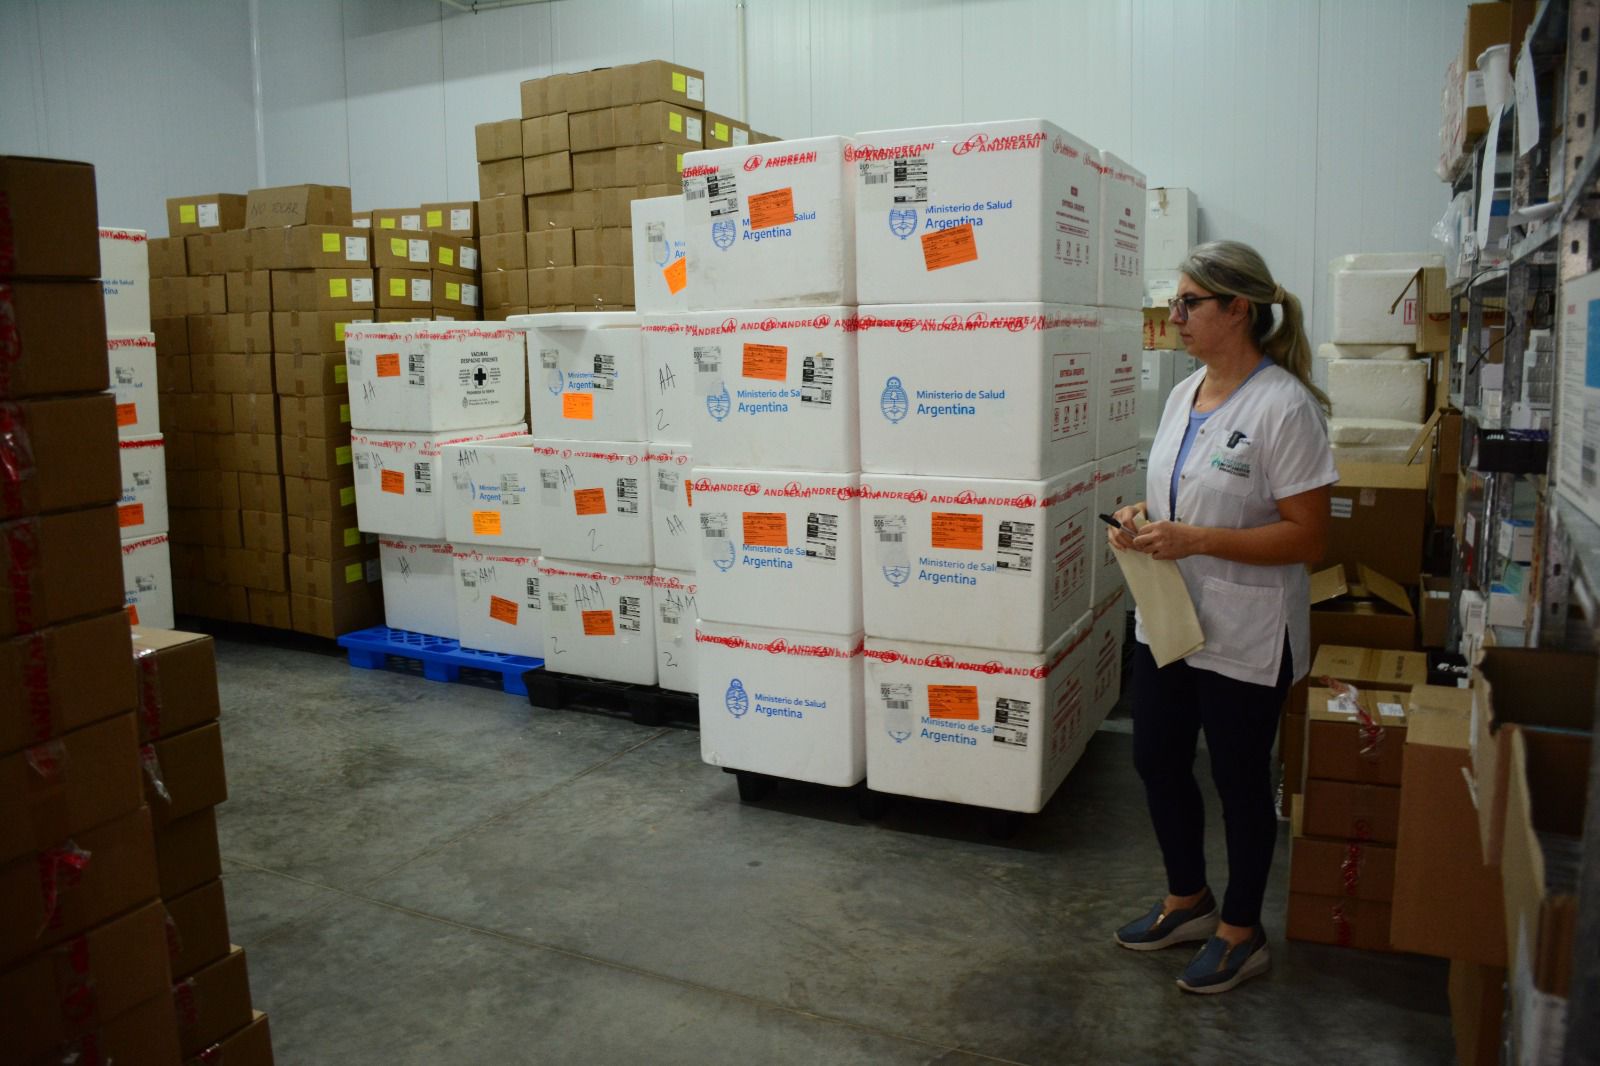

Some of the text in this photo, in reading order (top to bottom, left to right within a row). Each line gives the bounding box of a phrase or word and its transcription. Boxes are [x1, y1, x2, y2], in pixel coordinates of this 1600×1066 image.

[765, 151, 817, 168] ANDREANI
[925, 200, 1012, 214] Ministerio de Salud
[794, 212, 816, 221] Salud
[925, 215, 983, 230] Argentina
[743, 228, 792, 242] Argentina
[737, 389, 778, 399] Ministerio
[779, 388, 789, 398] de
[916, 390, 1005, 400] Ministerio de Salud
[738, 402, 788, 415] Argentina
[916, 403, 975, 417] Argentina
[656, 408, 670, 431] 2
[743, 543, 782, 554] Ministerio
[784, 547, 794, 555] de
[743, 555, 793, 569] Argentina
[919, 557, 966, 571] Ministerio
[968, 562, 979, 571] de
[918, 570, 977, 586] Argentina
[754, 693, 826, 708] Ministerio de Salud
[755, 703, 803, 719] Argentina
[921, 716, 995, 734] Ministerio de Sal
[920, 728, 977, 746] Argentina
